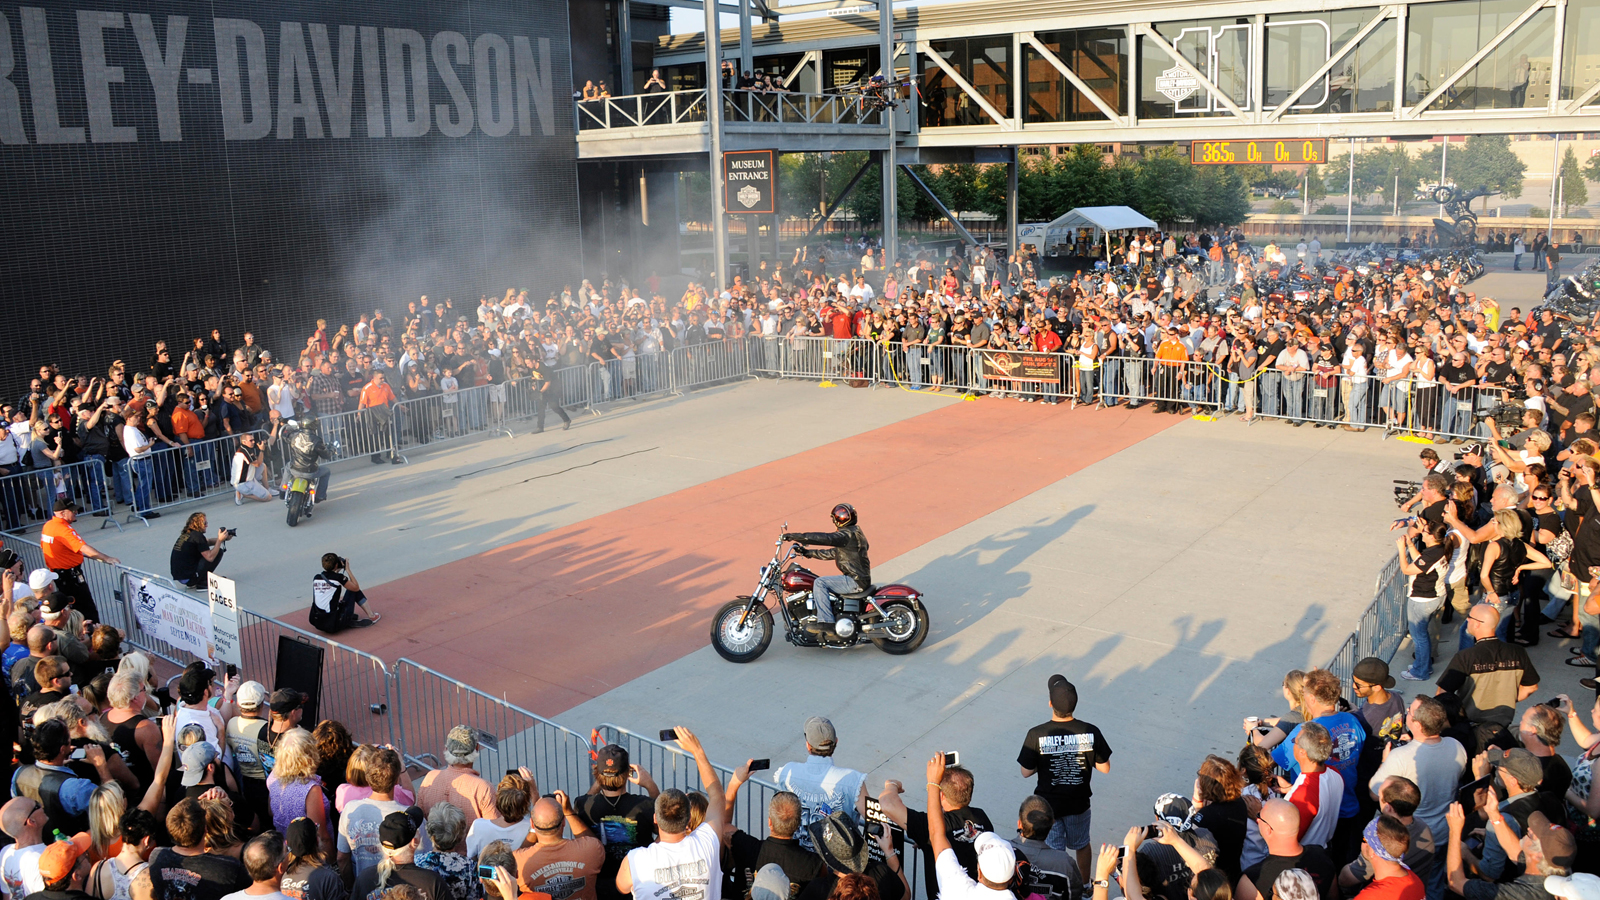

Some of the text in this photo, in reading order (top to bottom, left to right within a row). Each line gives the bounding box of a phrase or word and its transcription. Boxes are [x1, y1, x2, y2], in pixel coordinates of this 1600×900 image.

[731, 160, 765, 169] MUSEUM
[728, 171, 769, 181] ENTRANCE
[209, 577, 218, 590] NO
[161, 608, 208, 639] MAN AND MACHINE
[170, 625, 197, 646] SEPTEMBER
[213, 625, 238, 642] Motorcycle
[214, 634, 232, 650] Parking
[1038, 732, 1094, 748] HARLEY-DAVIDSON
[866, 799, 882, 812] NO
[530, 861, 586, 880] HARLEY-DAVIDSON OF
